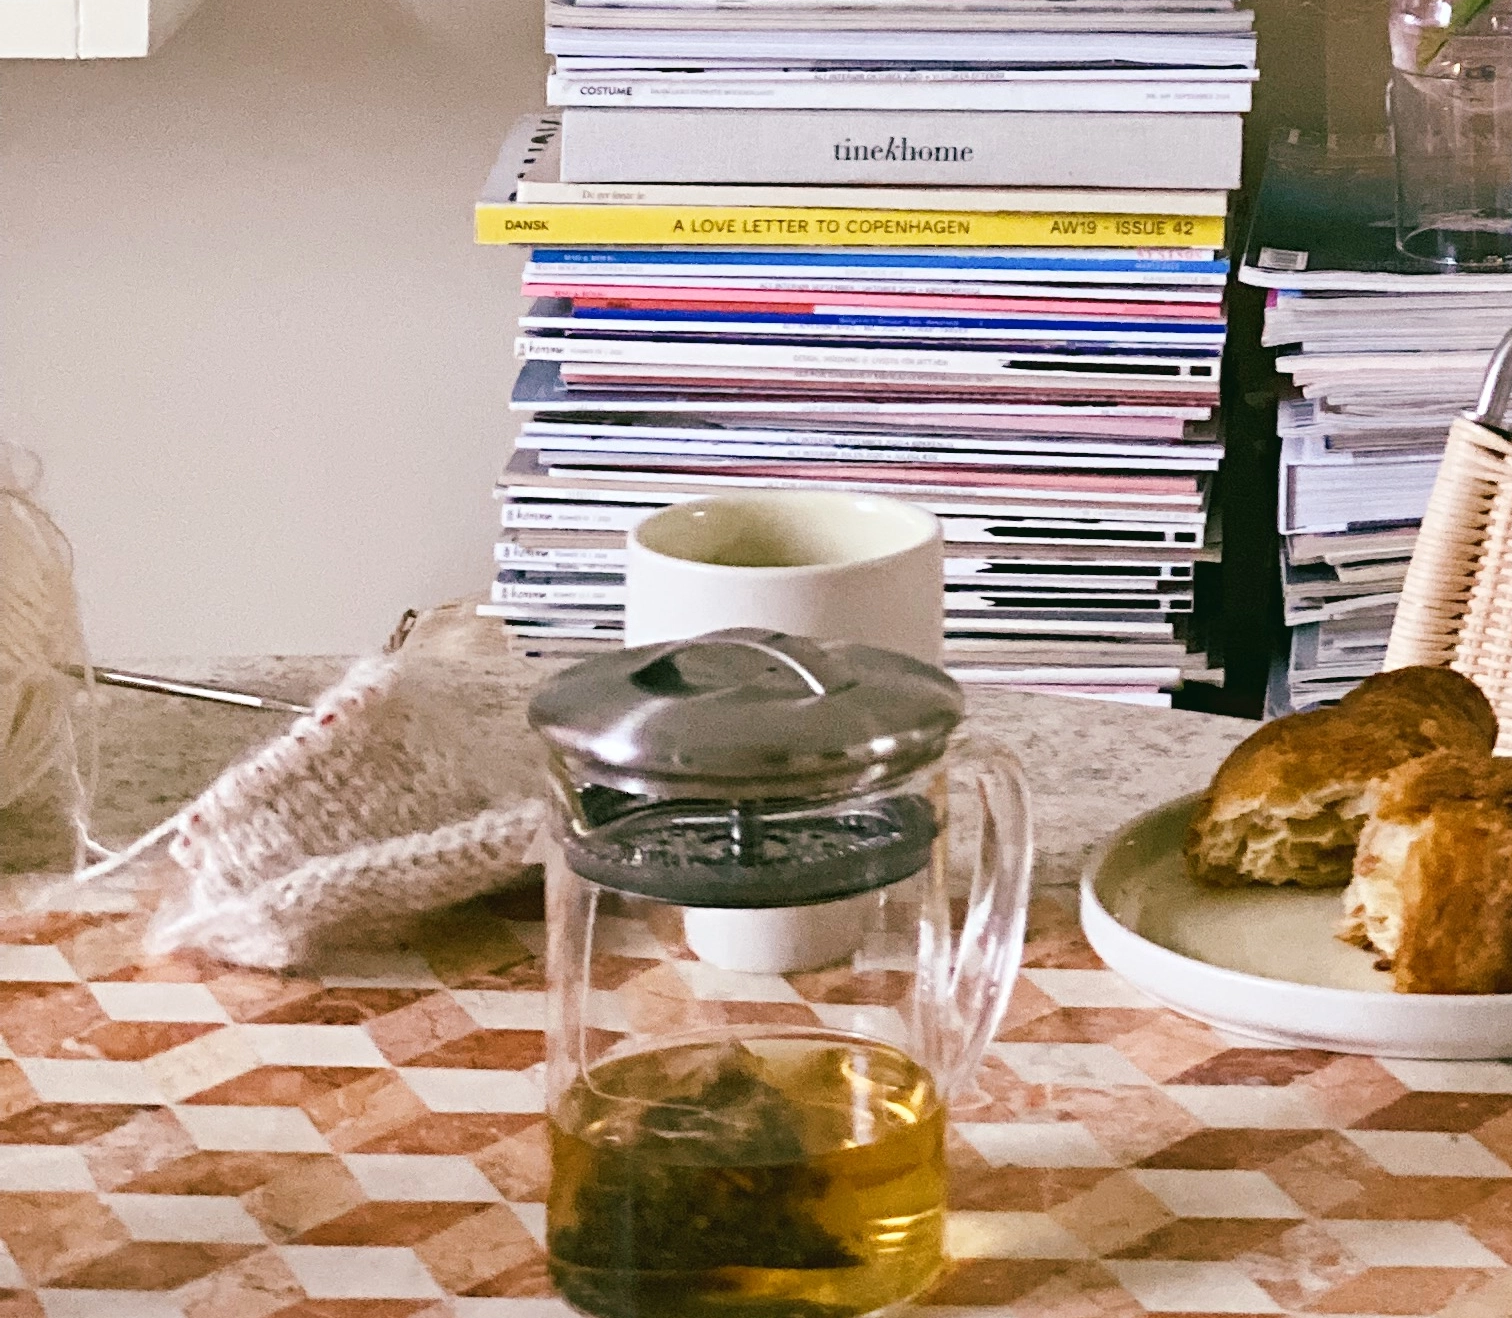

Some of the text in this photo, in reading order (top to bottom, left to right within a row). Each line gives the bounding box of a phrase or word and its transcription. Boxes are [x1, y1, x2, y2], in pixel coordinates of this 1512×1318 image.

[580, 86, 633, 96] COSTUME
[833, 137, 974, 163] tinekhome
[504, 219, 549, 231] DANSK
[673, 219, 971, 235] A LOVE LETTER TO COPENHAGEN
[1049, 220, 1096, 236] AW19
[1115, 220, 1166, 236] ISSUE
[1172, 221, 1195, 236] 42
